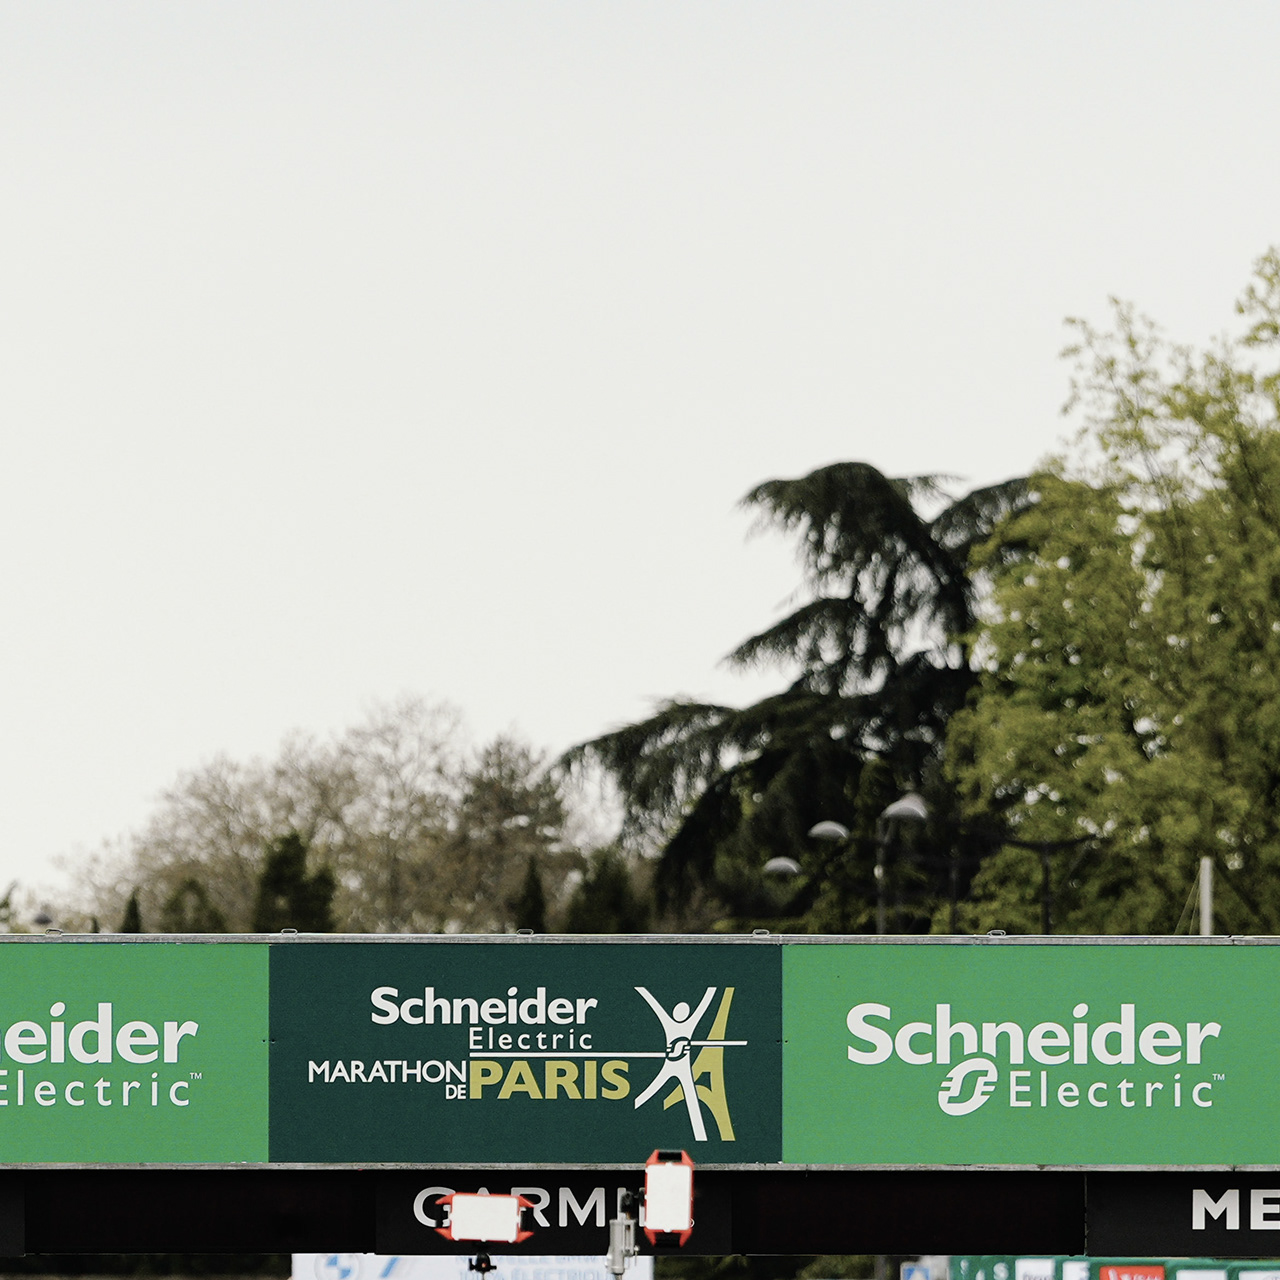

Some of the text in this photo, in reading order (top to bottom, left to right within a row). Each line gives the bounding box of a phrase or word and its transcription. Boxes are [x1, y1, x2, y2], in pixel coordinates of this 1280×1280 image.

[371, 987, 597, 1025] Schneider
[470, 1028, 592, 1049] Electric
[847, 1003, 1221, 1064] Schneider
[309, 1060, 631, 1099] MARATHON DE PARIS
[1010, 1071, 1214, 1107] Electric
